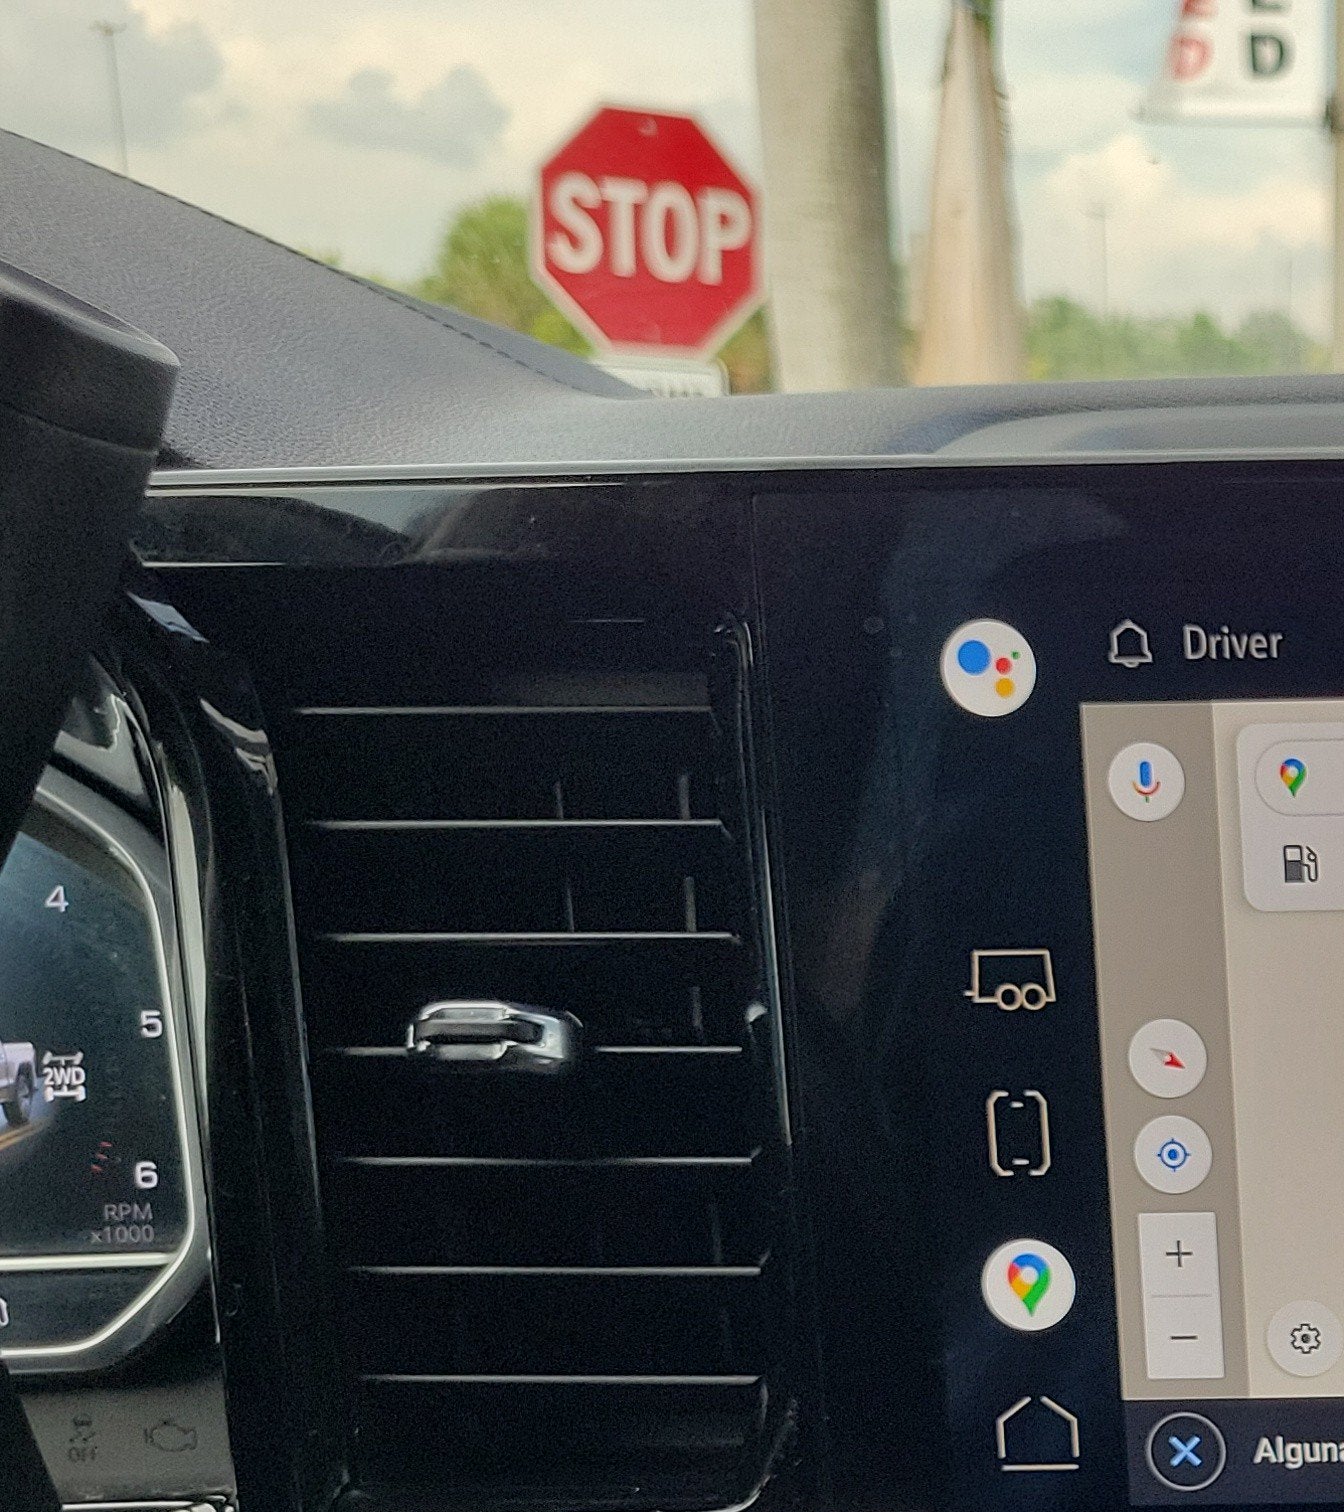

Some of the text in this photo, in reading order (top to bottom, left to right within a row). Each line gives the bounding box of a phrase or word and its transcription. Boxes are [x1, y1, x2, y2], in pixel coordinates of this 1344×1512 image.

[549, 172, 751, 286] STOP
[1182, 624, 1283, 660] Driver
[45, 885, 69, 912] 4
[140, 1010, 163, 1038] 5
[43, 1067, 85, 1086] 2WD
[134, 1161, 158, 1189] 6
[104, 1203, 153, 1221] RPM
[91, 1225, 154, 1244] x1000
